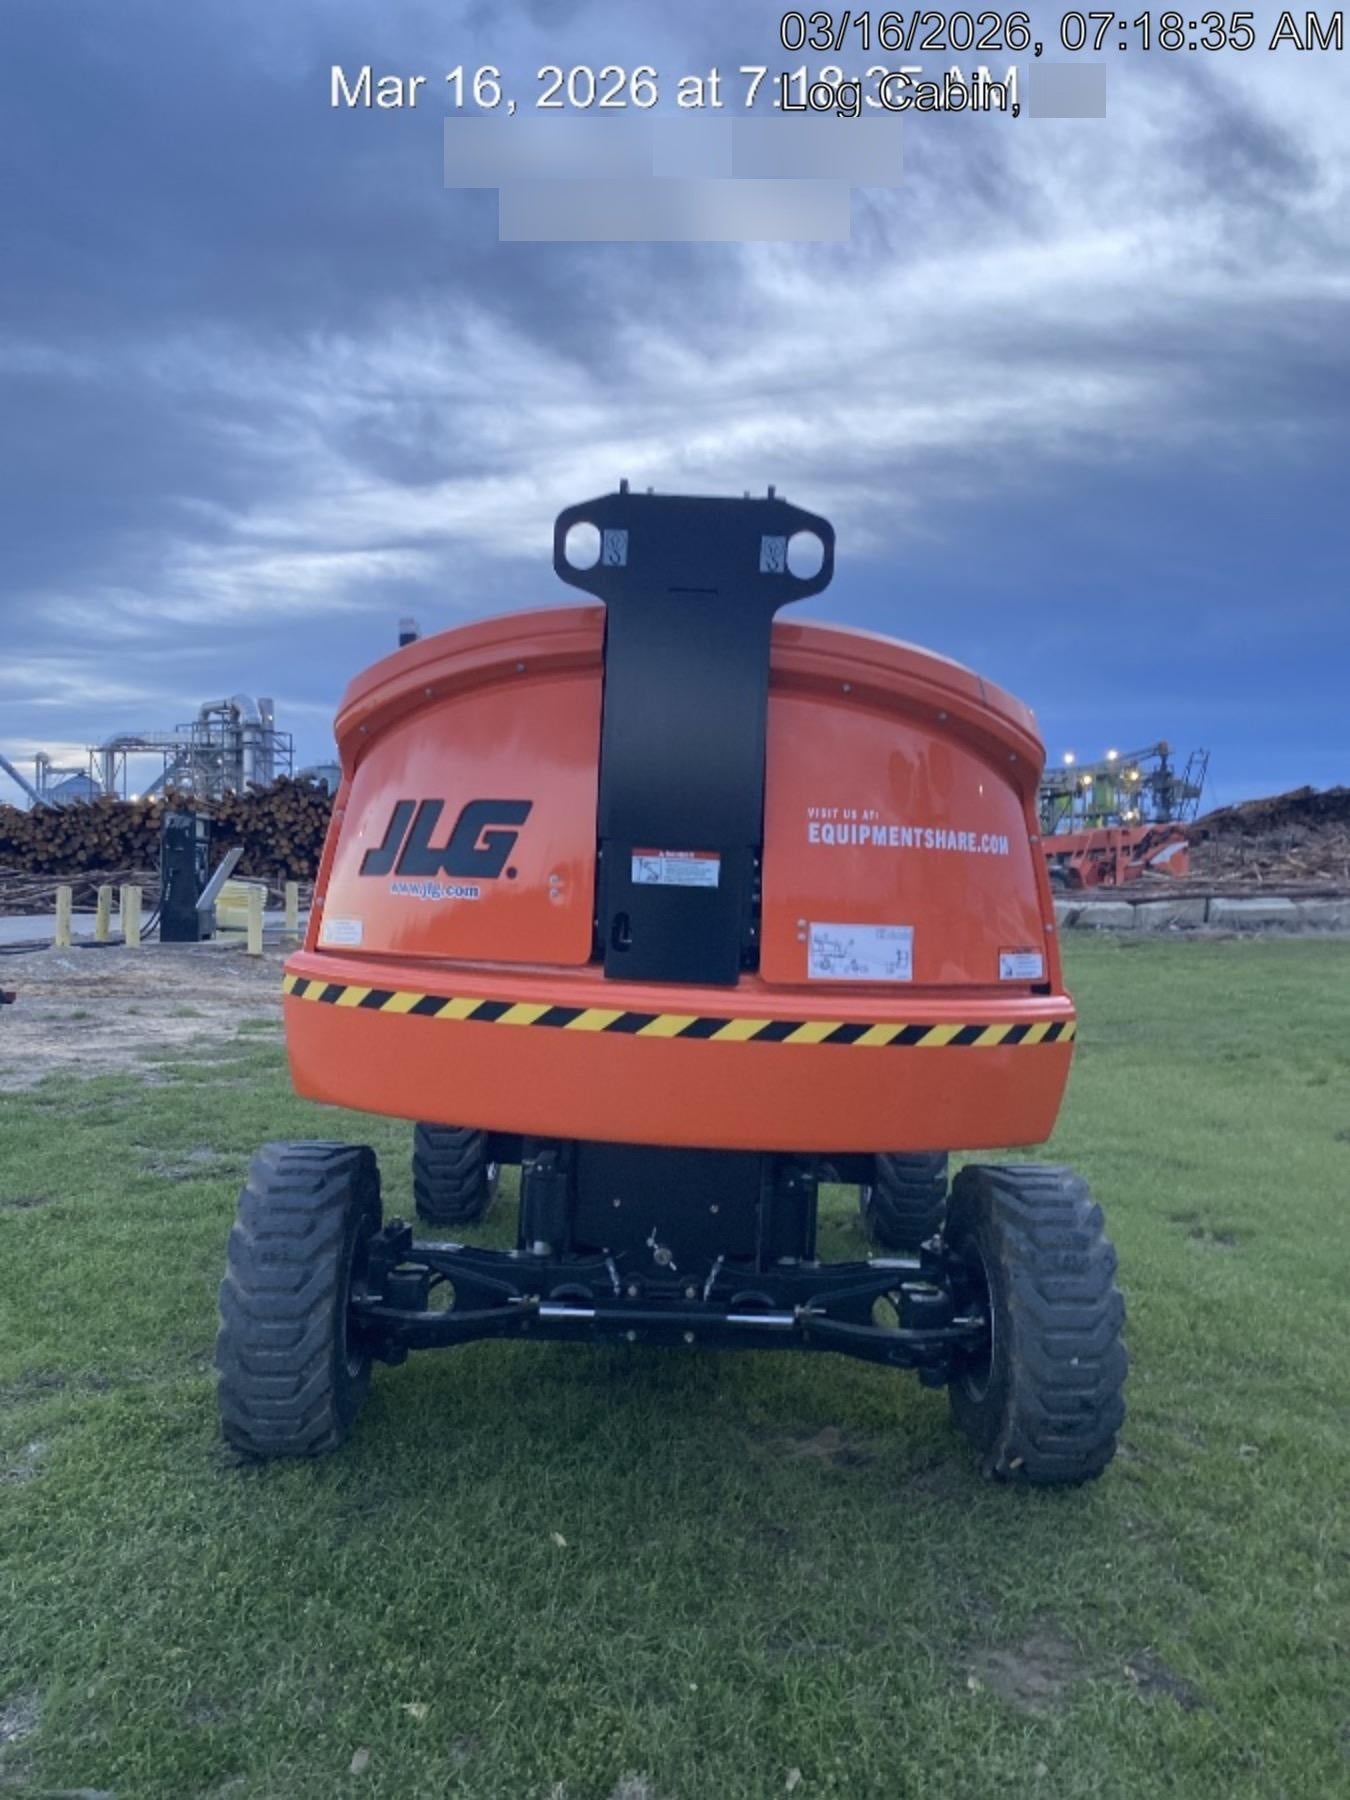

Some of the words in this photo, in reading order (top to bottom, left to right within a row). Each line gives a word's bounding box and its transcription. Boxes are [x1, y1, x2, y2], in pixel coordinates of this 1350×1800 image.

[807, 807, 838, 820] VISIT
[843, 808, 857, 820] US
[808, 823, 1008, 854] EQUIPMENTSHARE.COM
[389, 881, 480, 899] www.jlg.com
